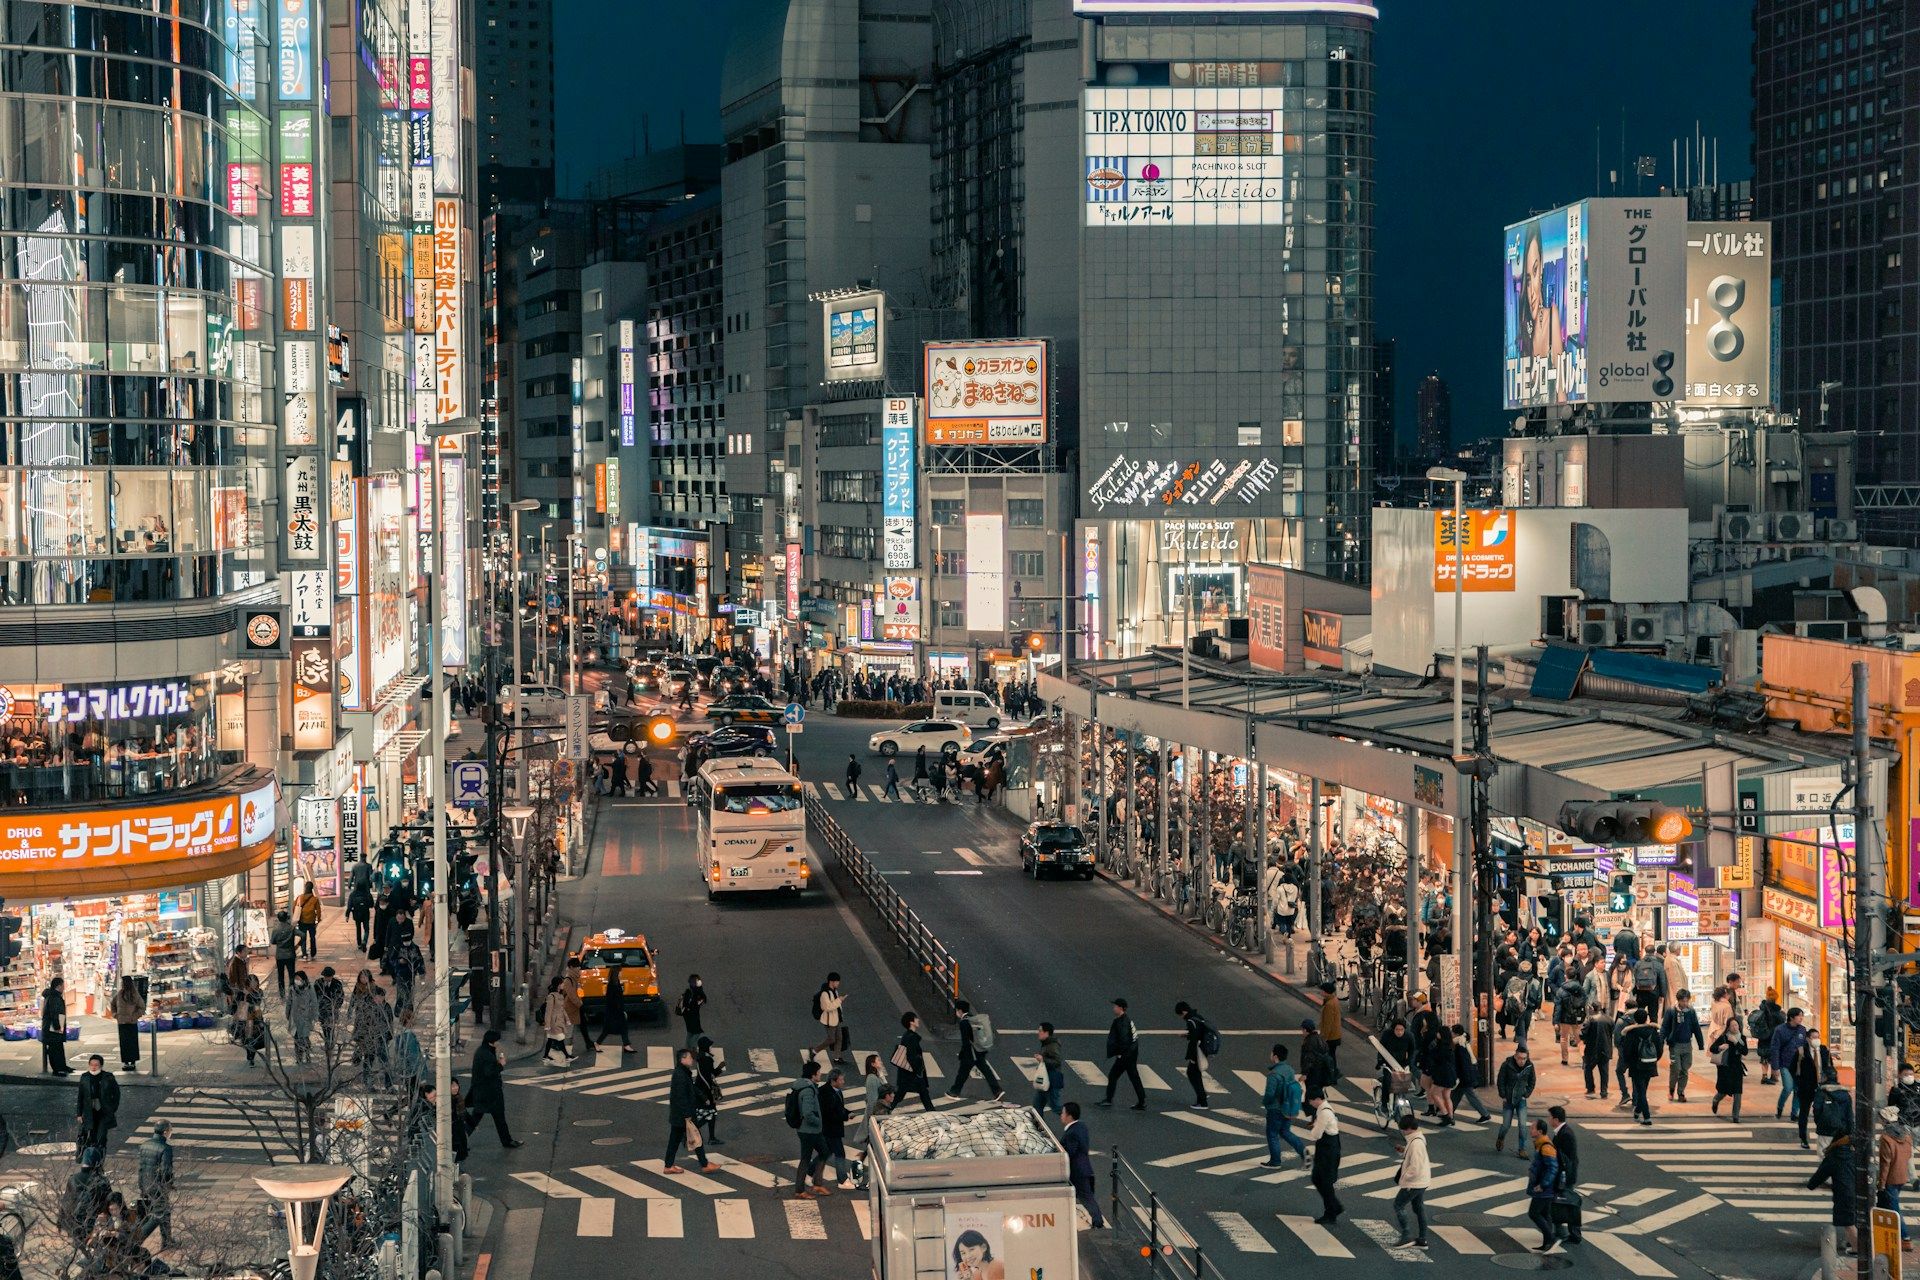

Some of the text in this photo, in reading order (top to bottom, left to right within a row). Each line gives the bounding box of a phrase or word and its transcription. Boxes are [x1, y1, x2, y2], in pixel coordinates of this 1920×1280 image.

[1134, 111, 1187, 132] TOKYO
[1192, 163, 1236, 171] PACHINKO
[1247, 162, 1268, 171] SLOT
[292, 166, 309, 213] 美容室
[1132, 187, 1169, 197] バーミヤン
[1182, 176, 1277, 200] Kaleido
[1118, 205, 1174, 220] ルノアール
[1624, 209, 1652, 218] THE
[415, 225, 432, 233] 4F
[1627, 225, 1647, 352] グローバル社
[977, 358, 1023, 375] カラオケ
[1600, 362, 1649, 387] global
[962, 380, 1039, 408] まねきねこ
[890, 400, 907, 411] ED
[888, 413, 909, 425] 薄毛
[948, 429, 984, 440] ワンカラ
[887, 438, 899, 506] クリニック
[899, 432, 910, 513] ユナイテッド
[1181, 458, 1227, 505] ワンカラ
[293, 470, 314, 551] 九州黒太鼓
[885, 518, 913, 527] 徒歩1分
[1164, 522, 1207, 531] PACHNKO
[1215, 521, 1234, 530] SLOT
[315, 571, 324, 609] 喫茶室
[304, 627, 319, 636] B1
[900, 626, 918, 637] すぐ
[1250, 600, 1284, 652] 大黒屋
[7, 827, 42, 839] DRUG
[59, 810, 214, 859] サンドラッグ
[343, 796, 357, 864] 時間営業
[20, 839, 29, 849] &
[1551, 861, 1595, 872] EXCHANGE
